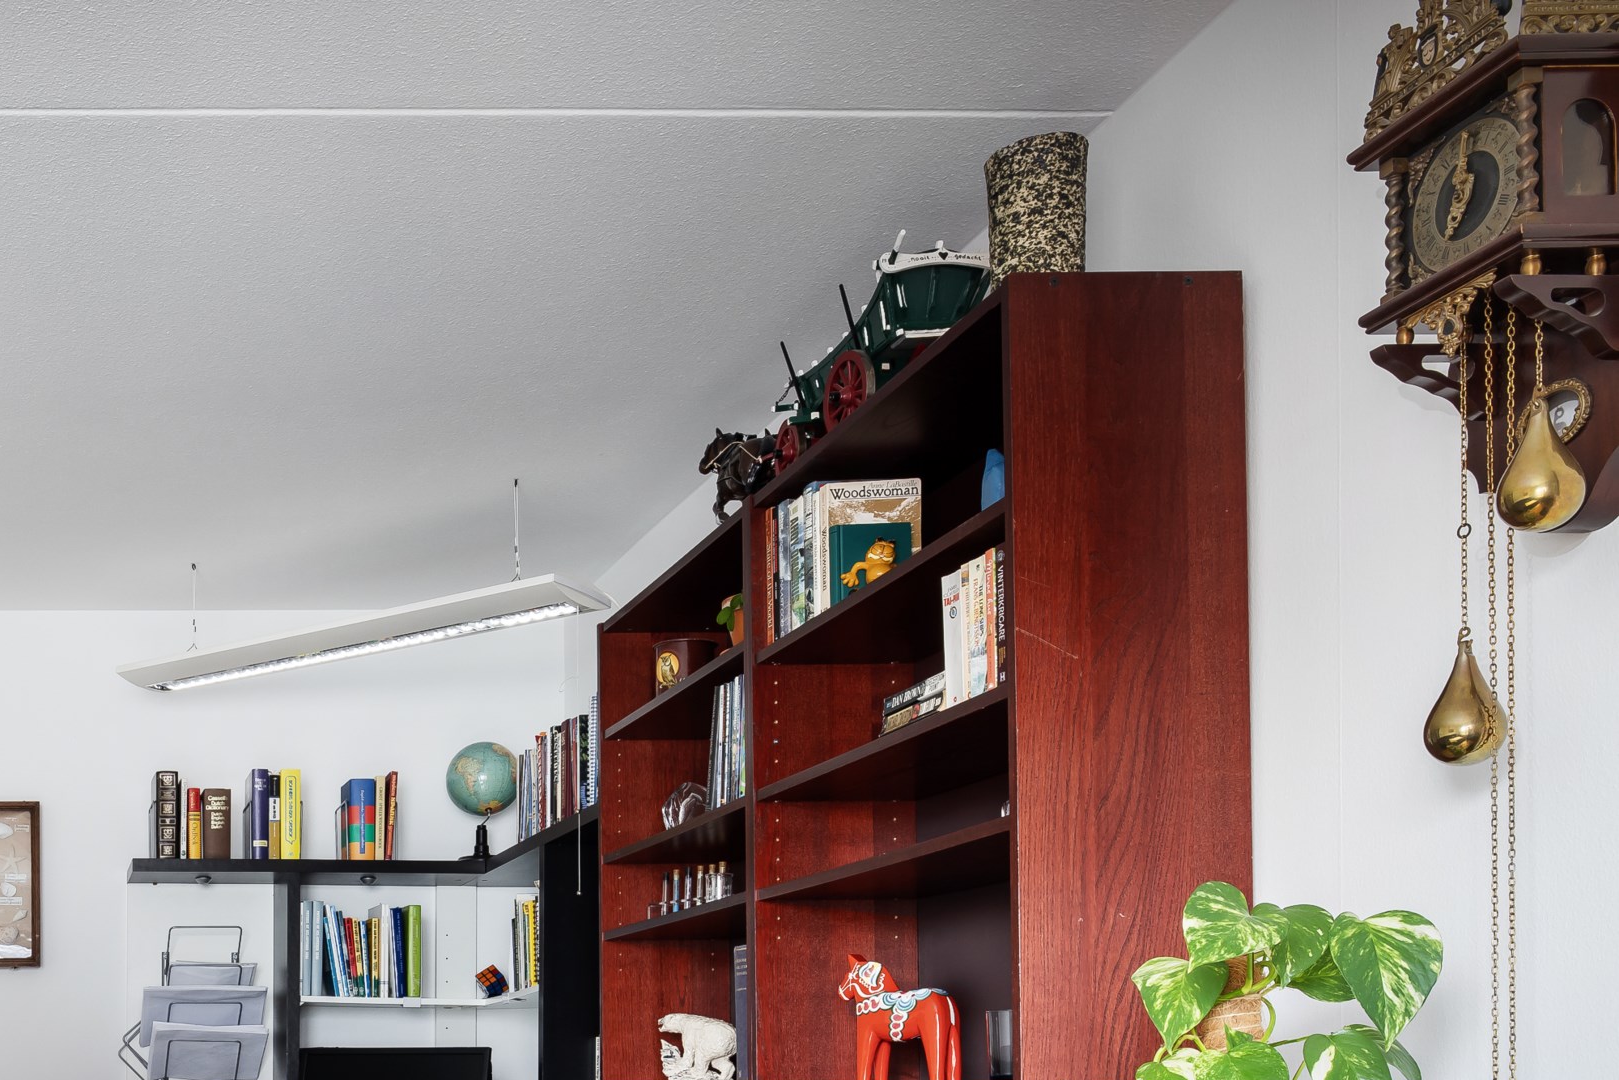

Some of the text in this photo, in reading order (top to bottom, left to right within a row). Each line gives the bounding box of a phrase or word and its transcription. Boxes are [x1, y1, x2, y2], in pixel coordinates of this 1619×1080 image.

[830, 486, 919, 500] Woodswoman
[997, 565, 1006, 641] VINTERKRIGARE
[892, 684, 922, 708] DAN BROWN
